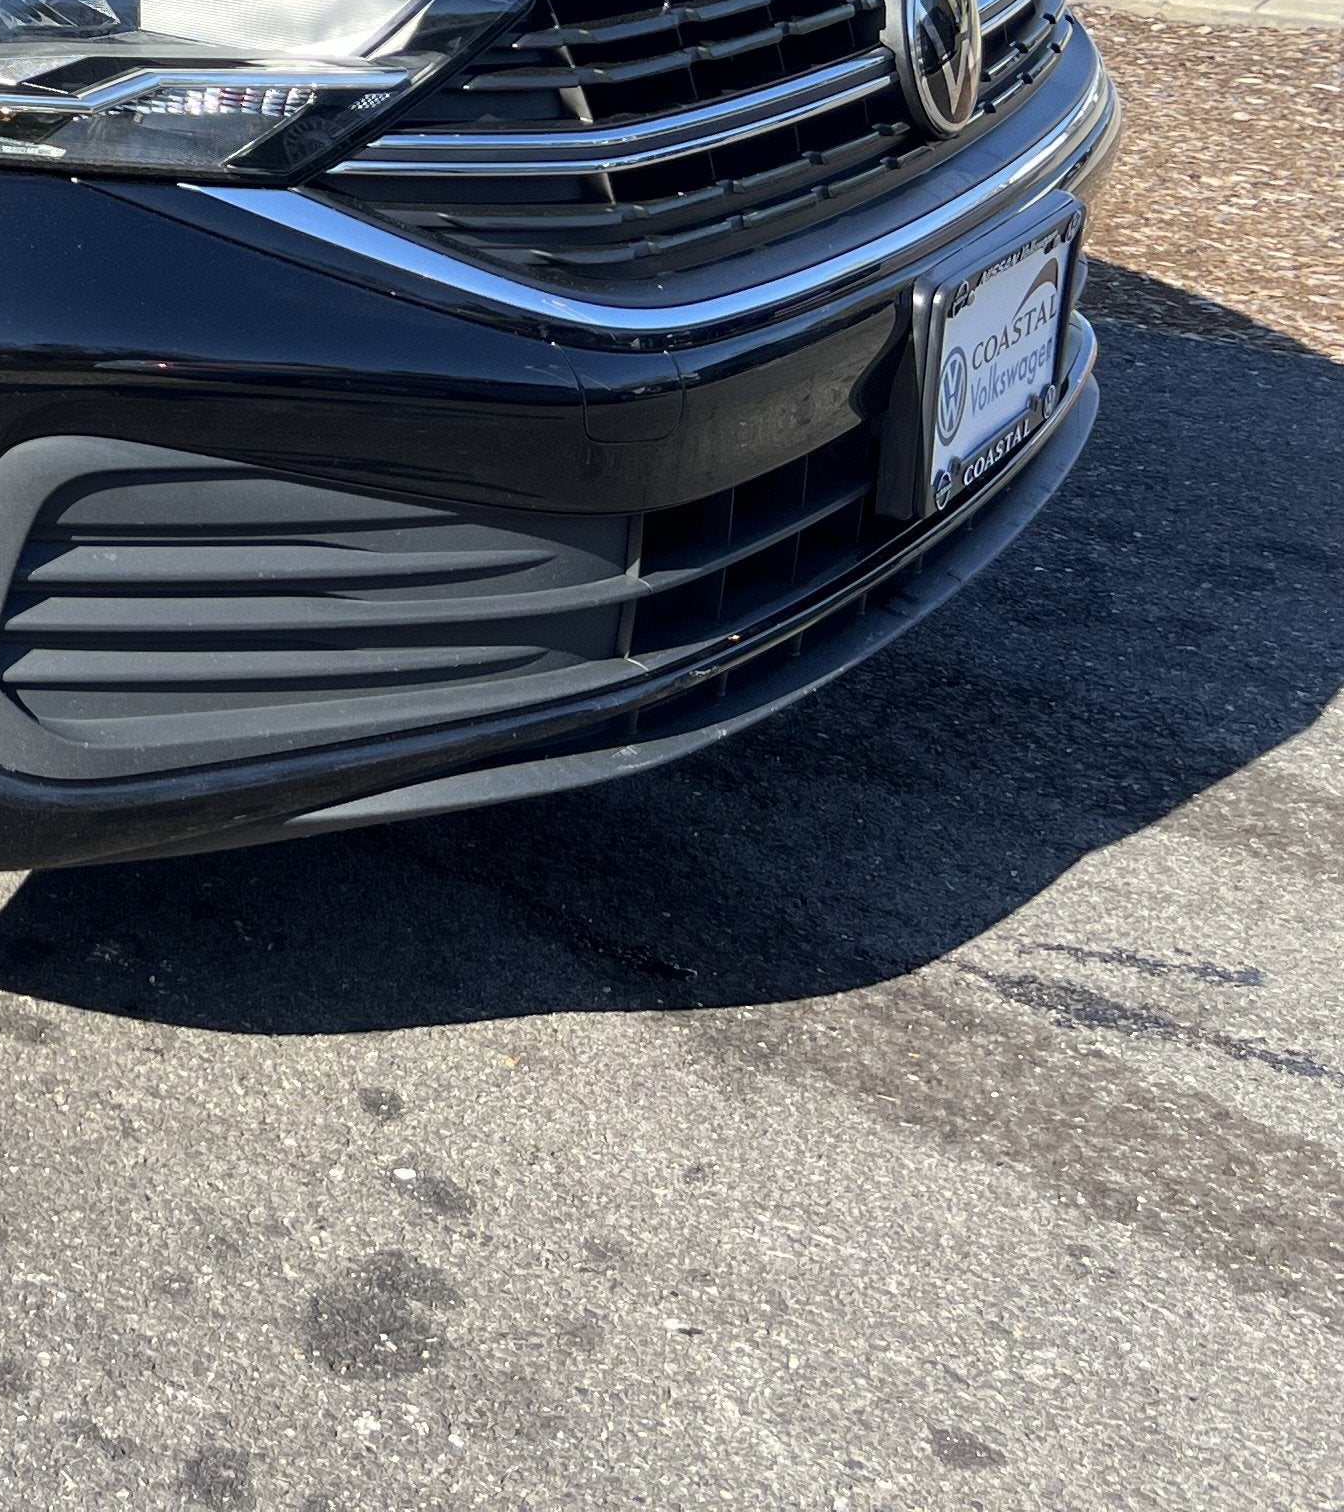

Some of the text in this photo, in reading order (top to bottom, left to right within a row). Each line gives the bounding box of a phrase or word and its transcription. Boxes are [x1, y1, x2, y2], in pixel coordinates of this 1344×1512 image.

[972, 293, 1058, 371] COASTAL
[970, 337, 1054, 418] Volkswagen
[962, 417, 1032, 487] COASTAL
